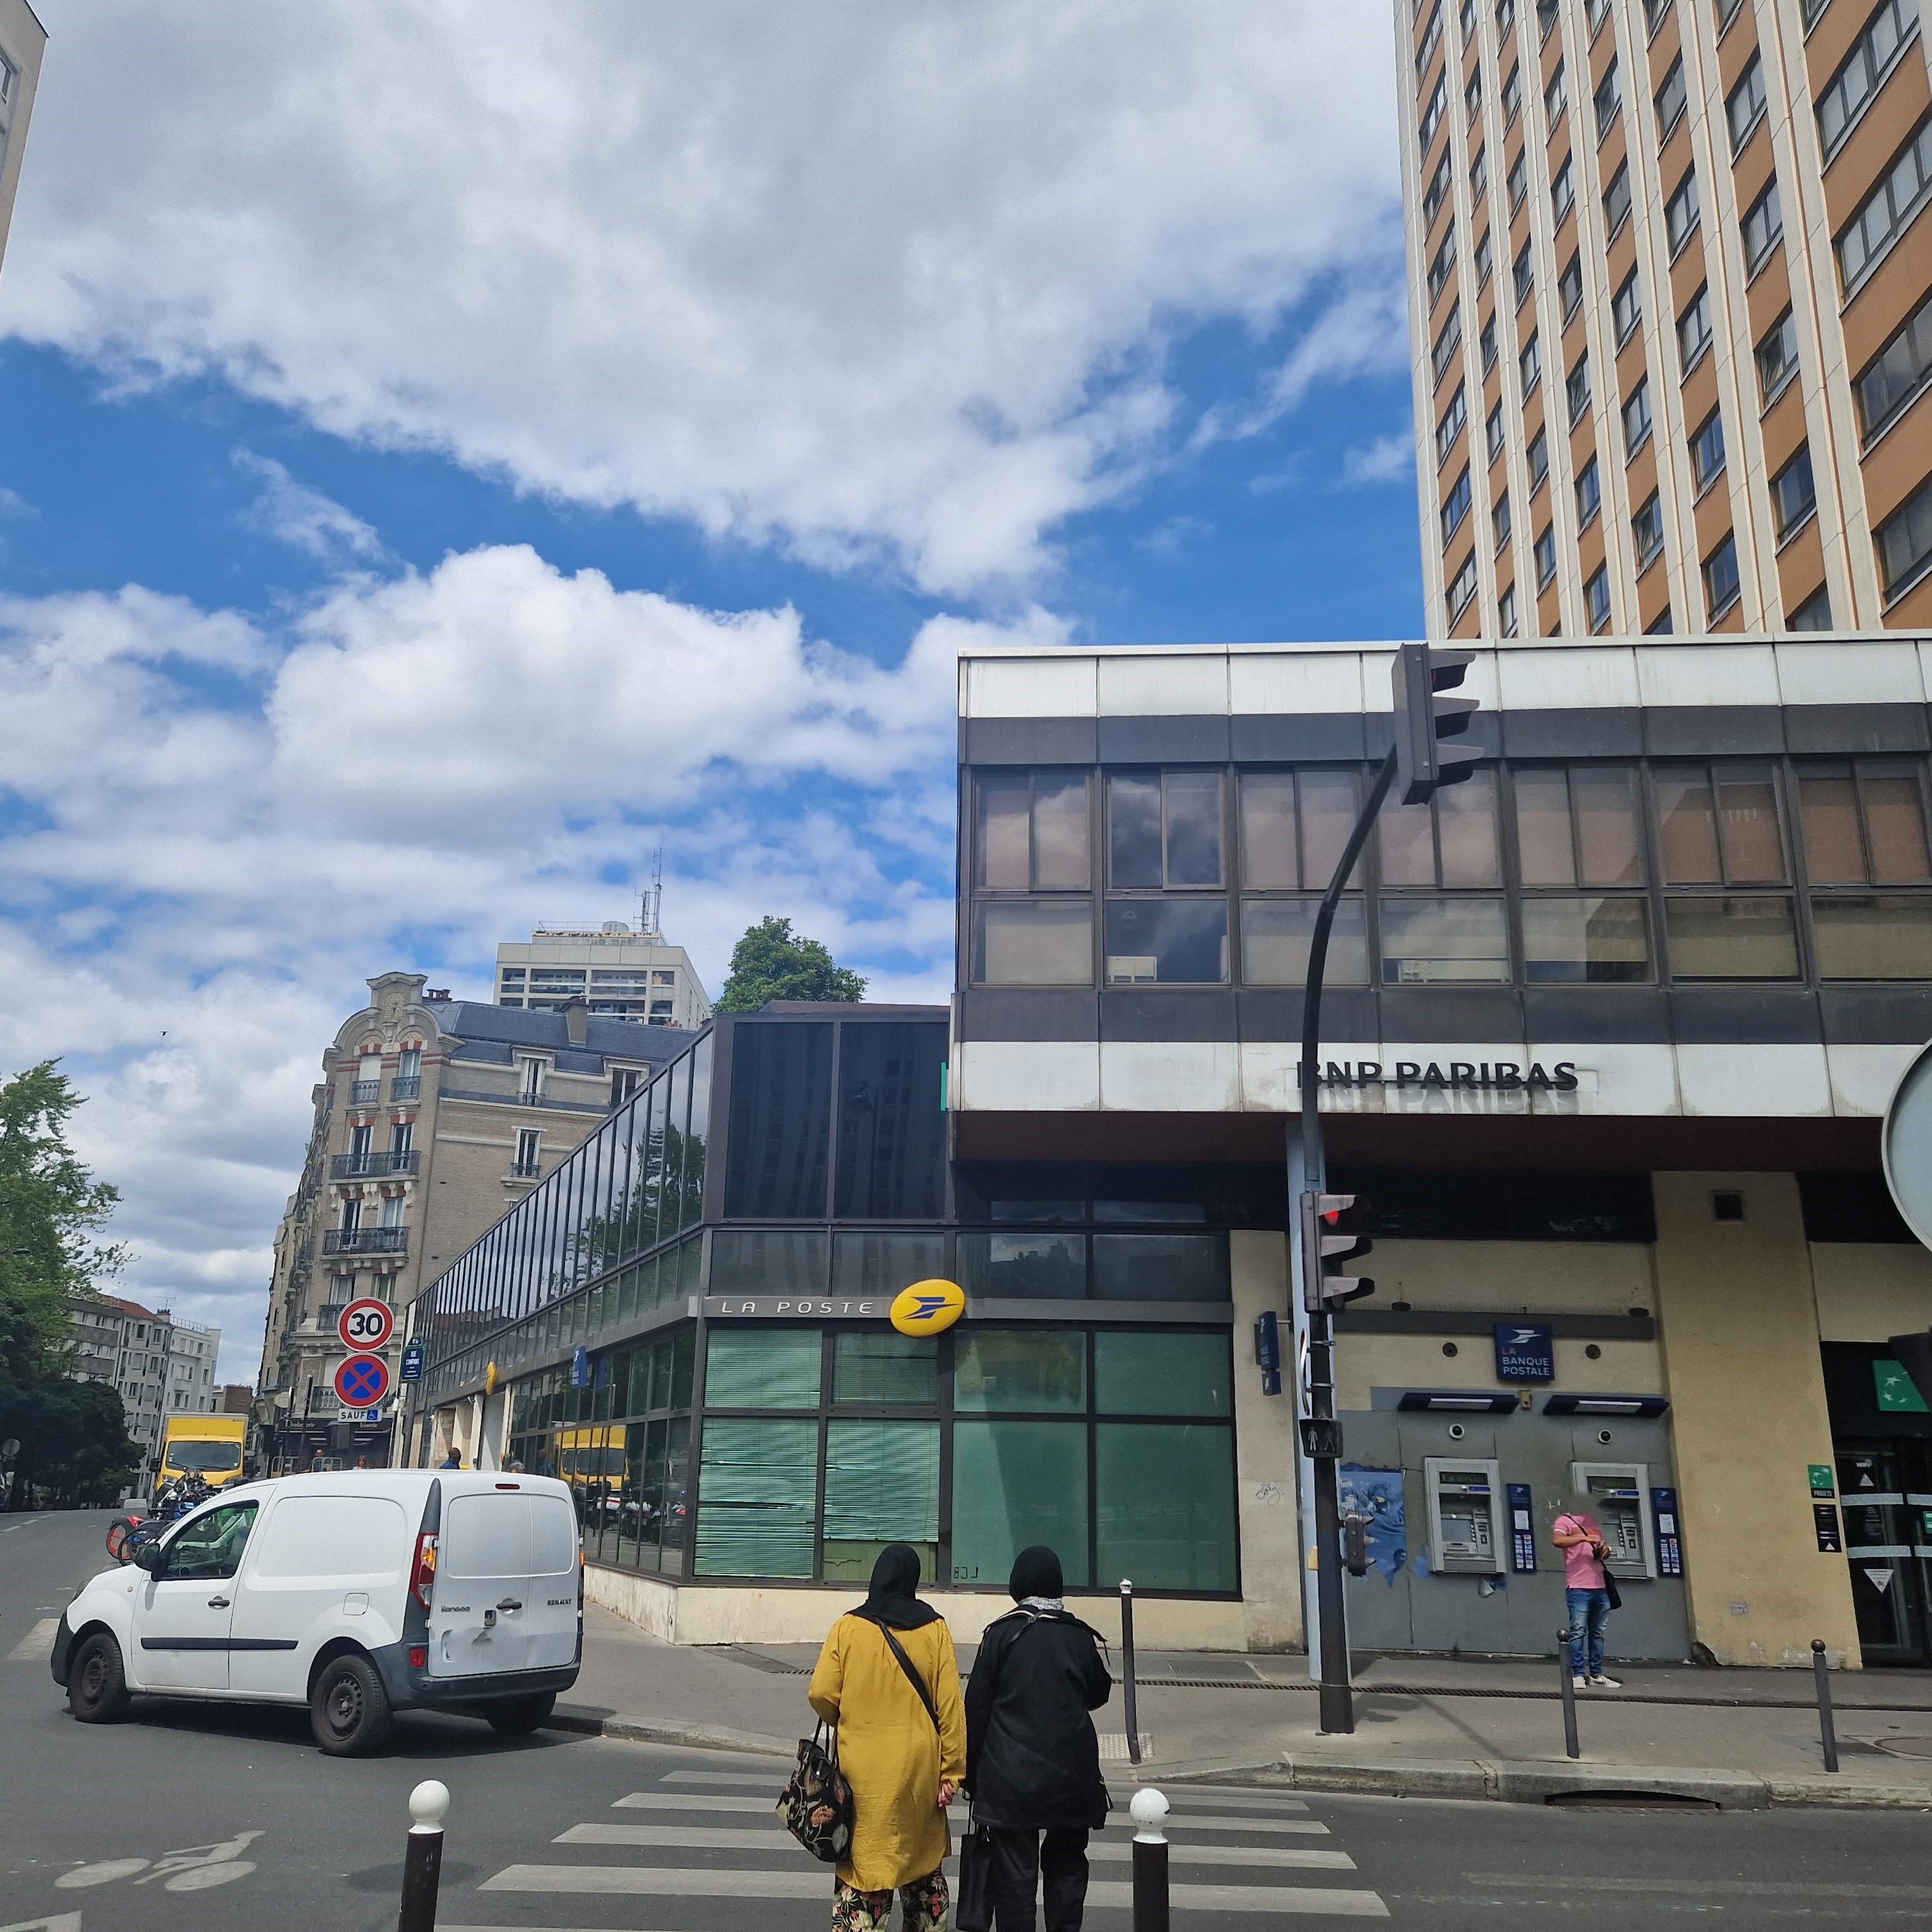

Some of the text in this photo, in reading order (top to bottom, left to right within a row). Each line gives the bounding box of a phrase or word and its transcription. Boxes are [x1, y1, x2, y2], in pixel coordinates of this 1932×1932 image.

[1395, 1062, 1578, 1091] PARIBAS
[721, 1301, 874, 1315] LA POSTE
[349, 1313, 383, 1336] 30
[1502, 1357, 1550, 1366] BANQUE
[1503, 1366, 1550, 1376] POSTALE
[340, 1411, 366, 1419] SAUF
[547, 1598, 571, 1607] RENAULT
